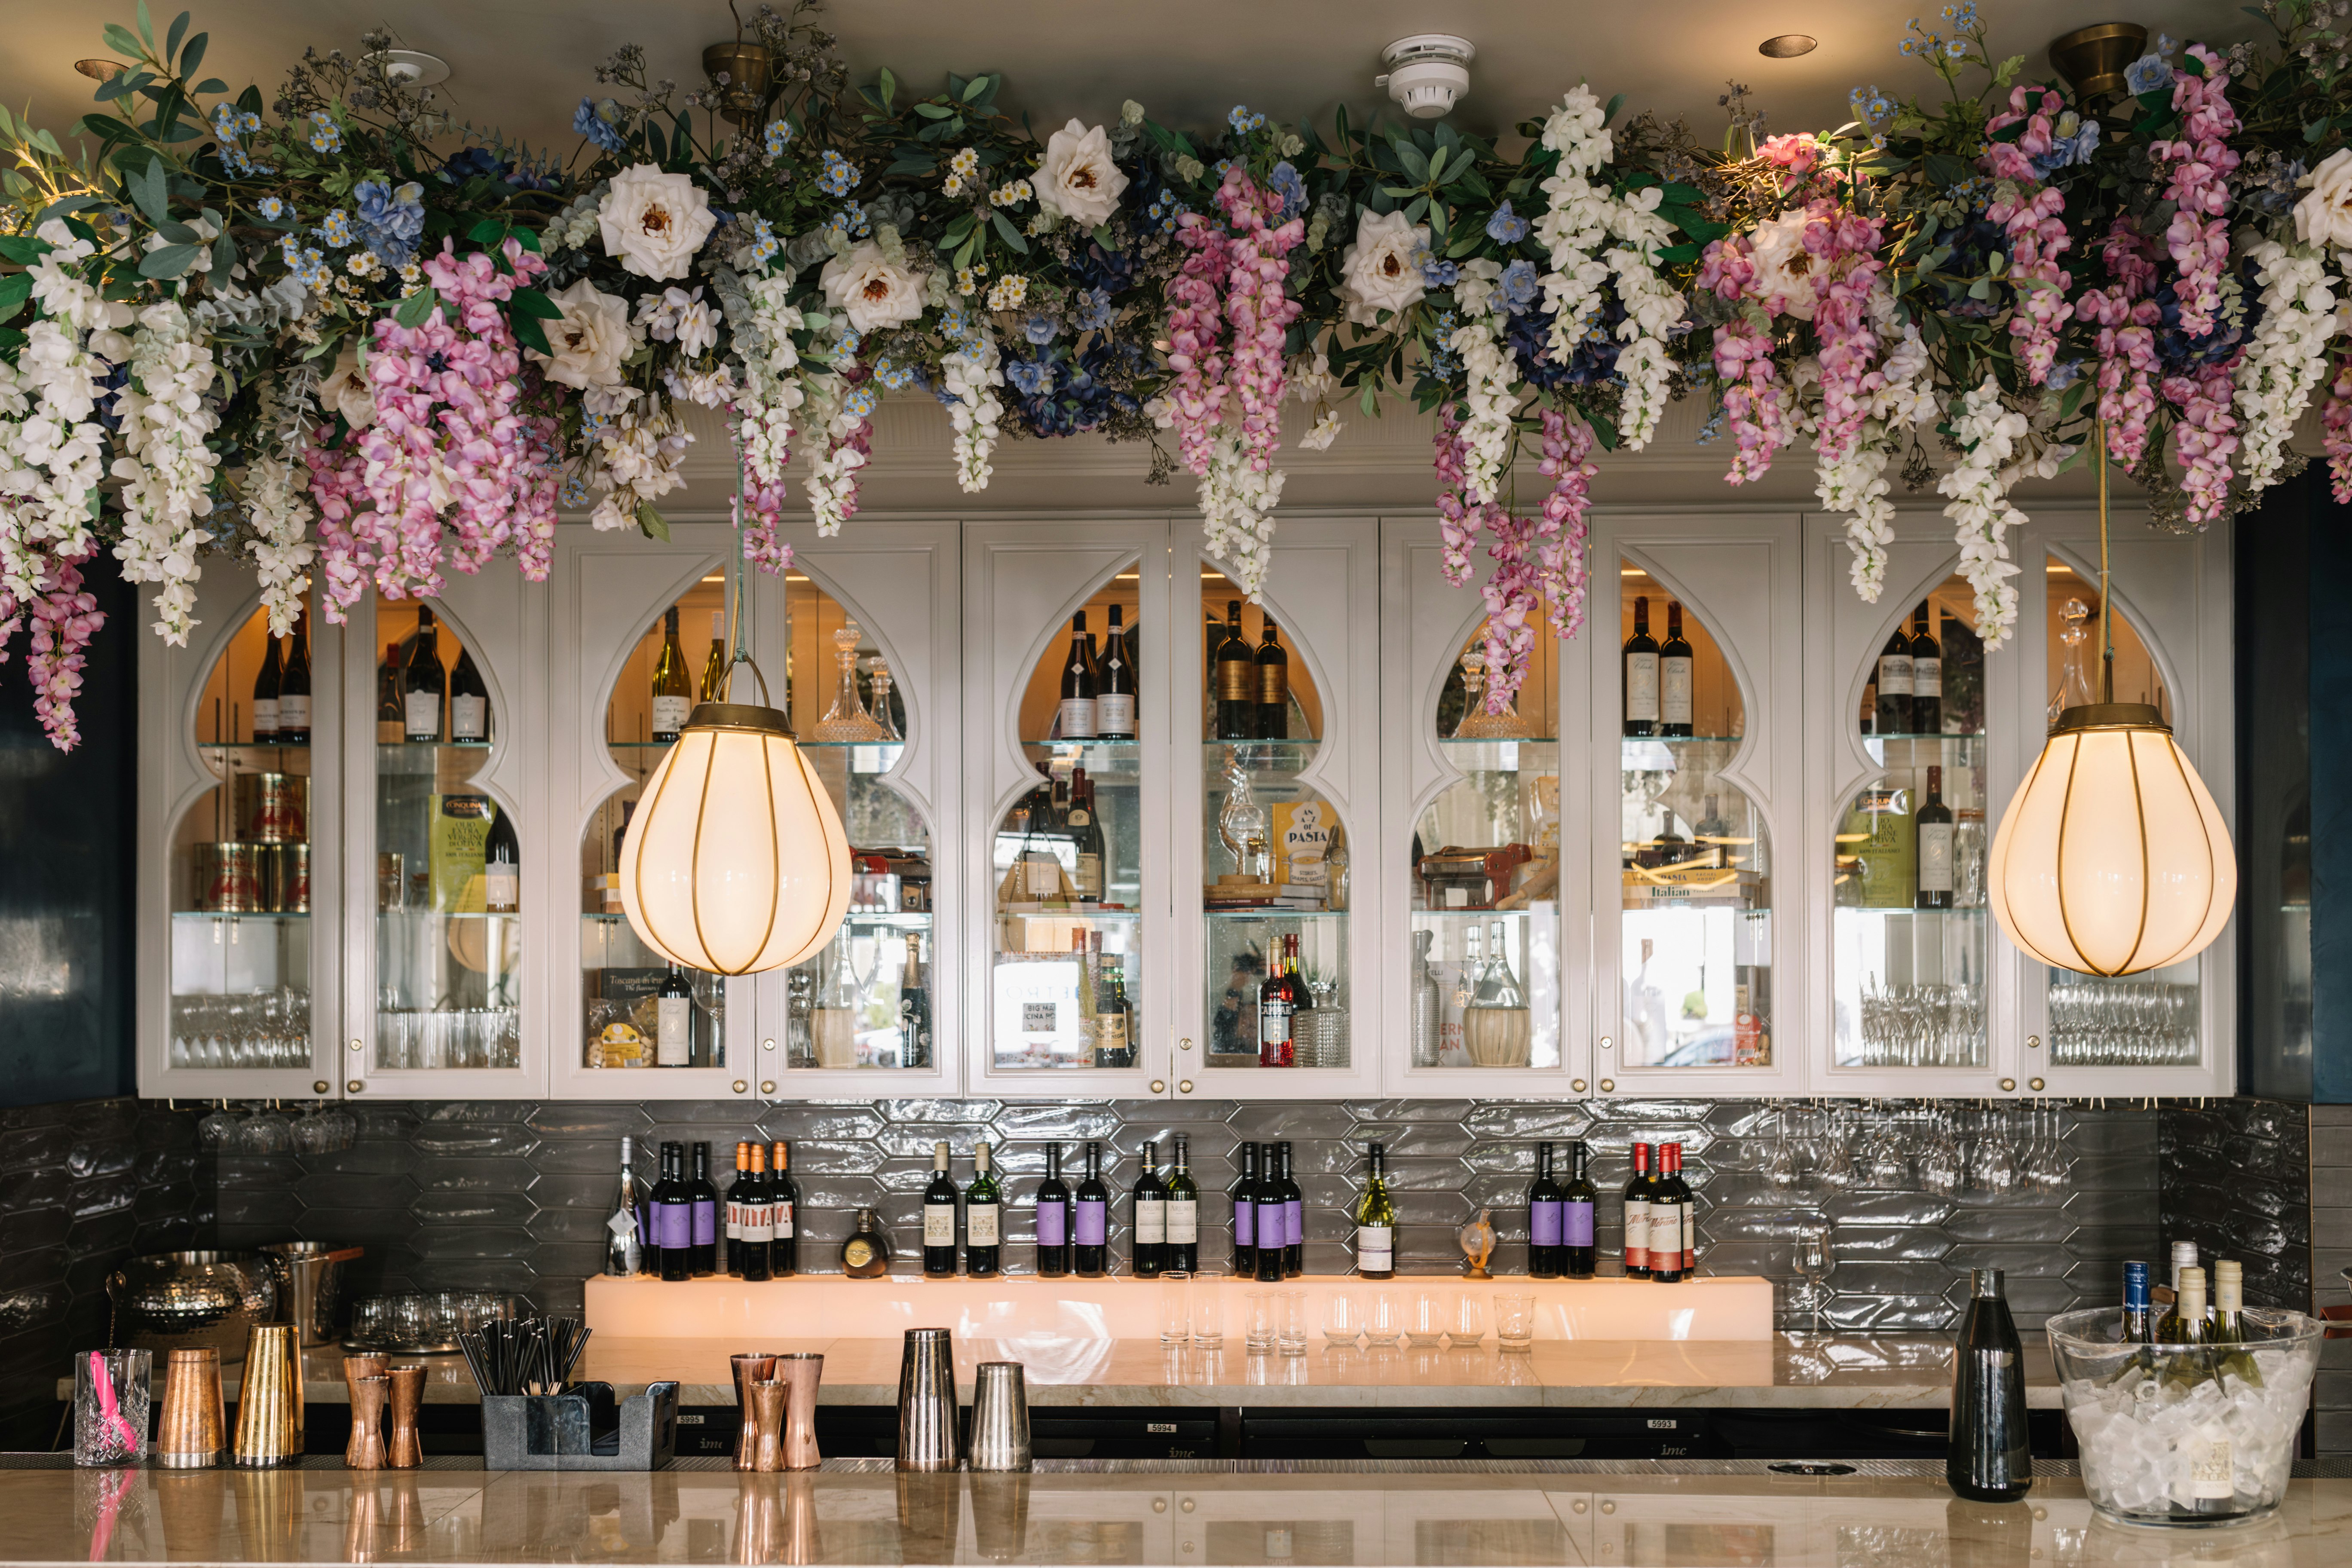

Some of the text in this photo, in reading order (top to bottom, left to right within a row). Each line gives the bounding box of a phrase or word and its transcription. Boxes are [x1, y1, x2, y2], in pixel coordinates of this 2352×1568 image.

[1289, 832, 1327, 842] PASTA
[1652, 886, 1690, 897] Italian
[1261, 1006, 1292, 1015] CAMPARI
[741, 1208, 773, 1227] VITA
[1649, 1217, 1678, 1228] Morano
[1169, 1447, 1195, 1458] imc
[1660, 1444, 1687, 1455] imc
